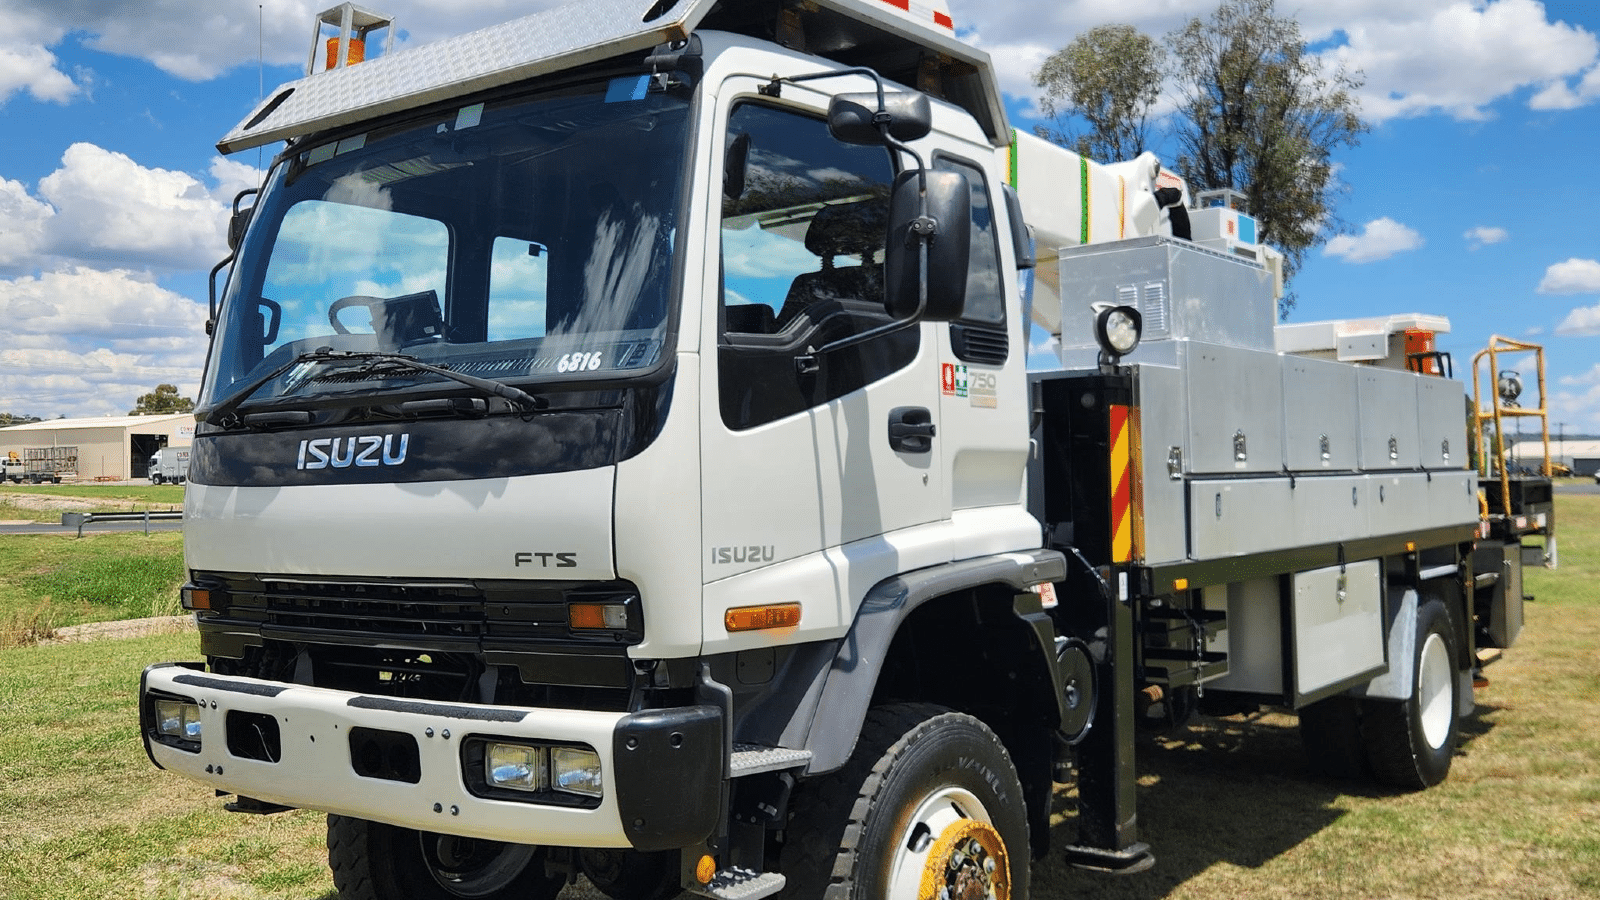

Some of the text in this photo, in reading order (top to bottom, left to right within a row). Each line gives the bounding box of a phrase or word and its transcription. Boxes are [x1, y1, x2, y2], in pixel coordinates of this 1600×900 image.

[557, 351, 602, 373] 6816
[969, 372, 997, 389] 750
[297, 433, 409, 470] ISUZU
[514, 552, 577, 567] FTS
[711, 545, 775, 564] ISUZU
